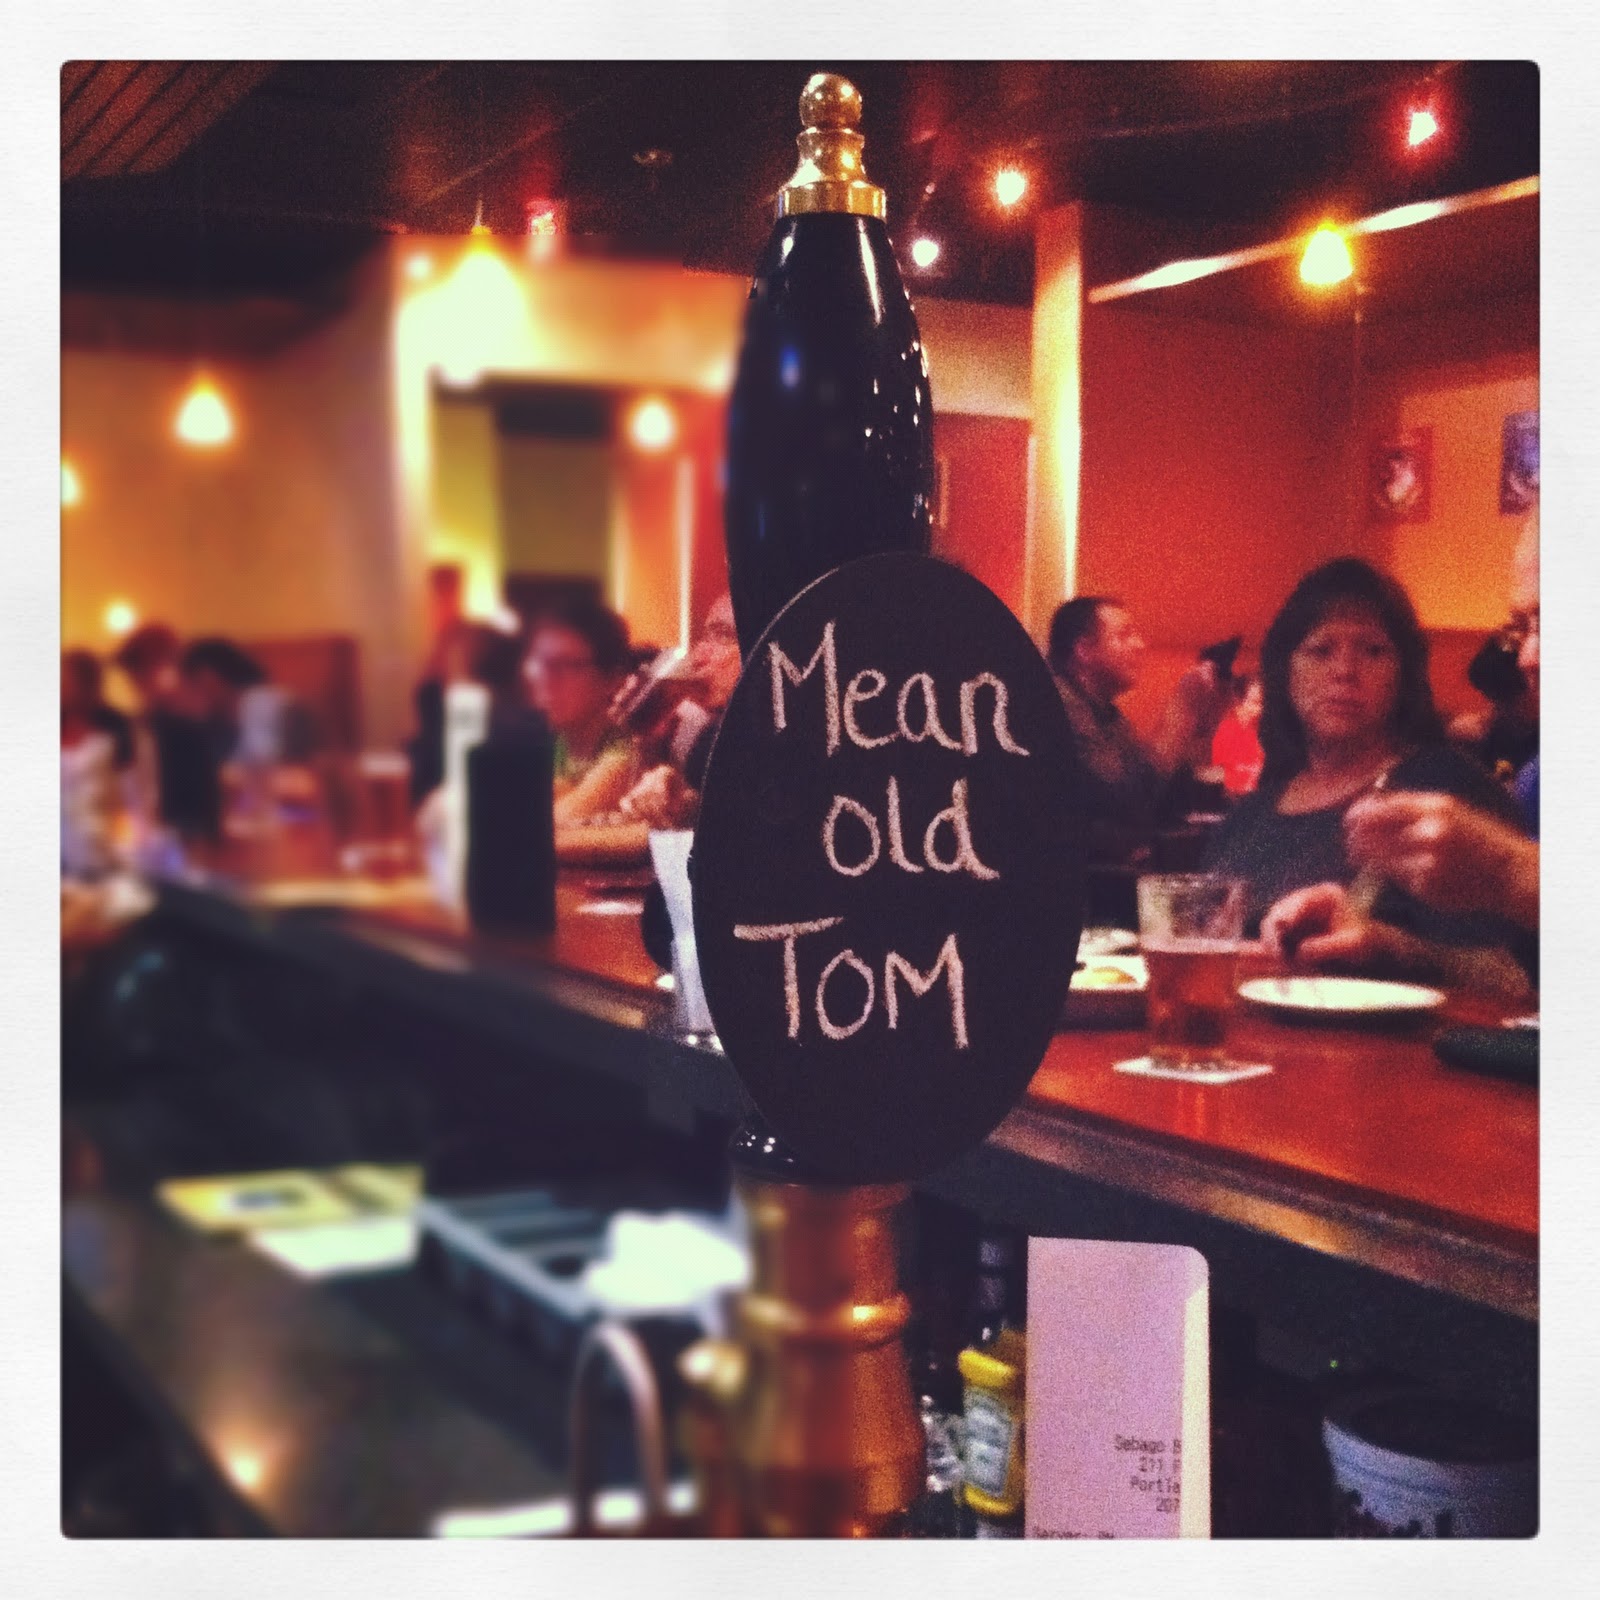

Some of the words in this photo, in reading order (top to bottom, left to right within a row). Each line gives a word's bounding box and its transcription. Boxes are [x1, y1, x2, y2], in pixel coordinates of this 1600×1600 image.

[768, 620, 1030, 757] Mean
[1115, 1434, 1166, 1454] Sebago
[1138, 1456, 1164, 1472] 211
